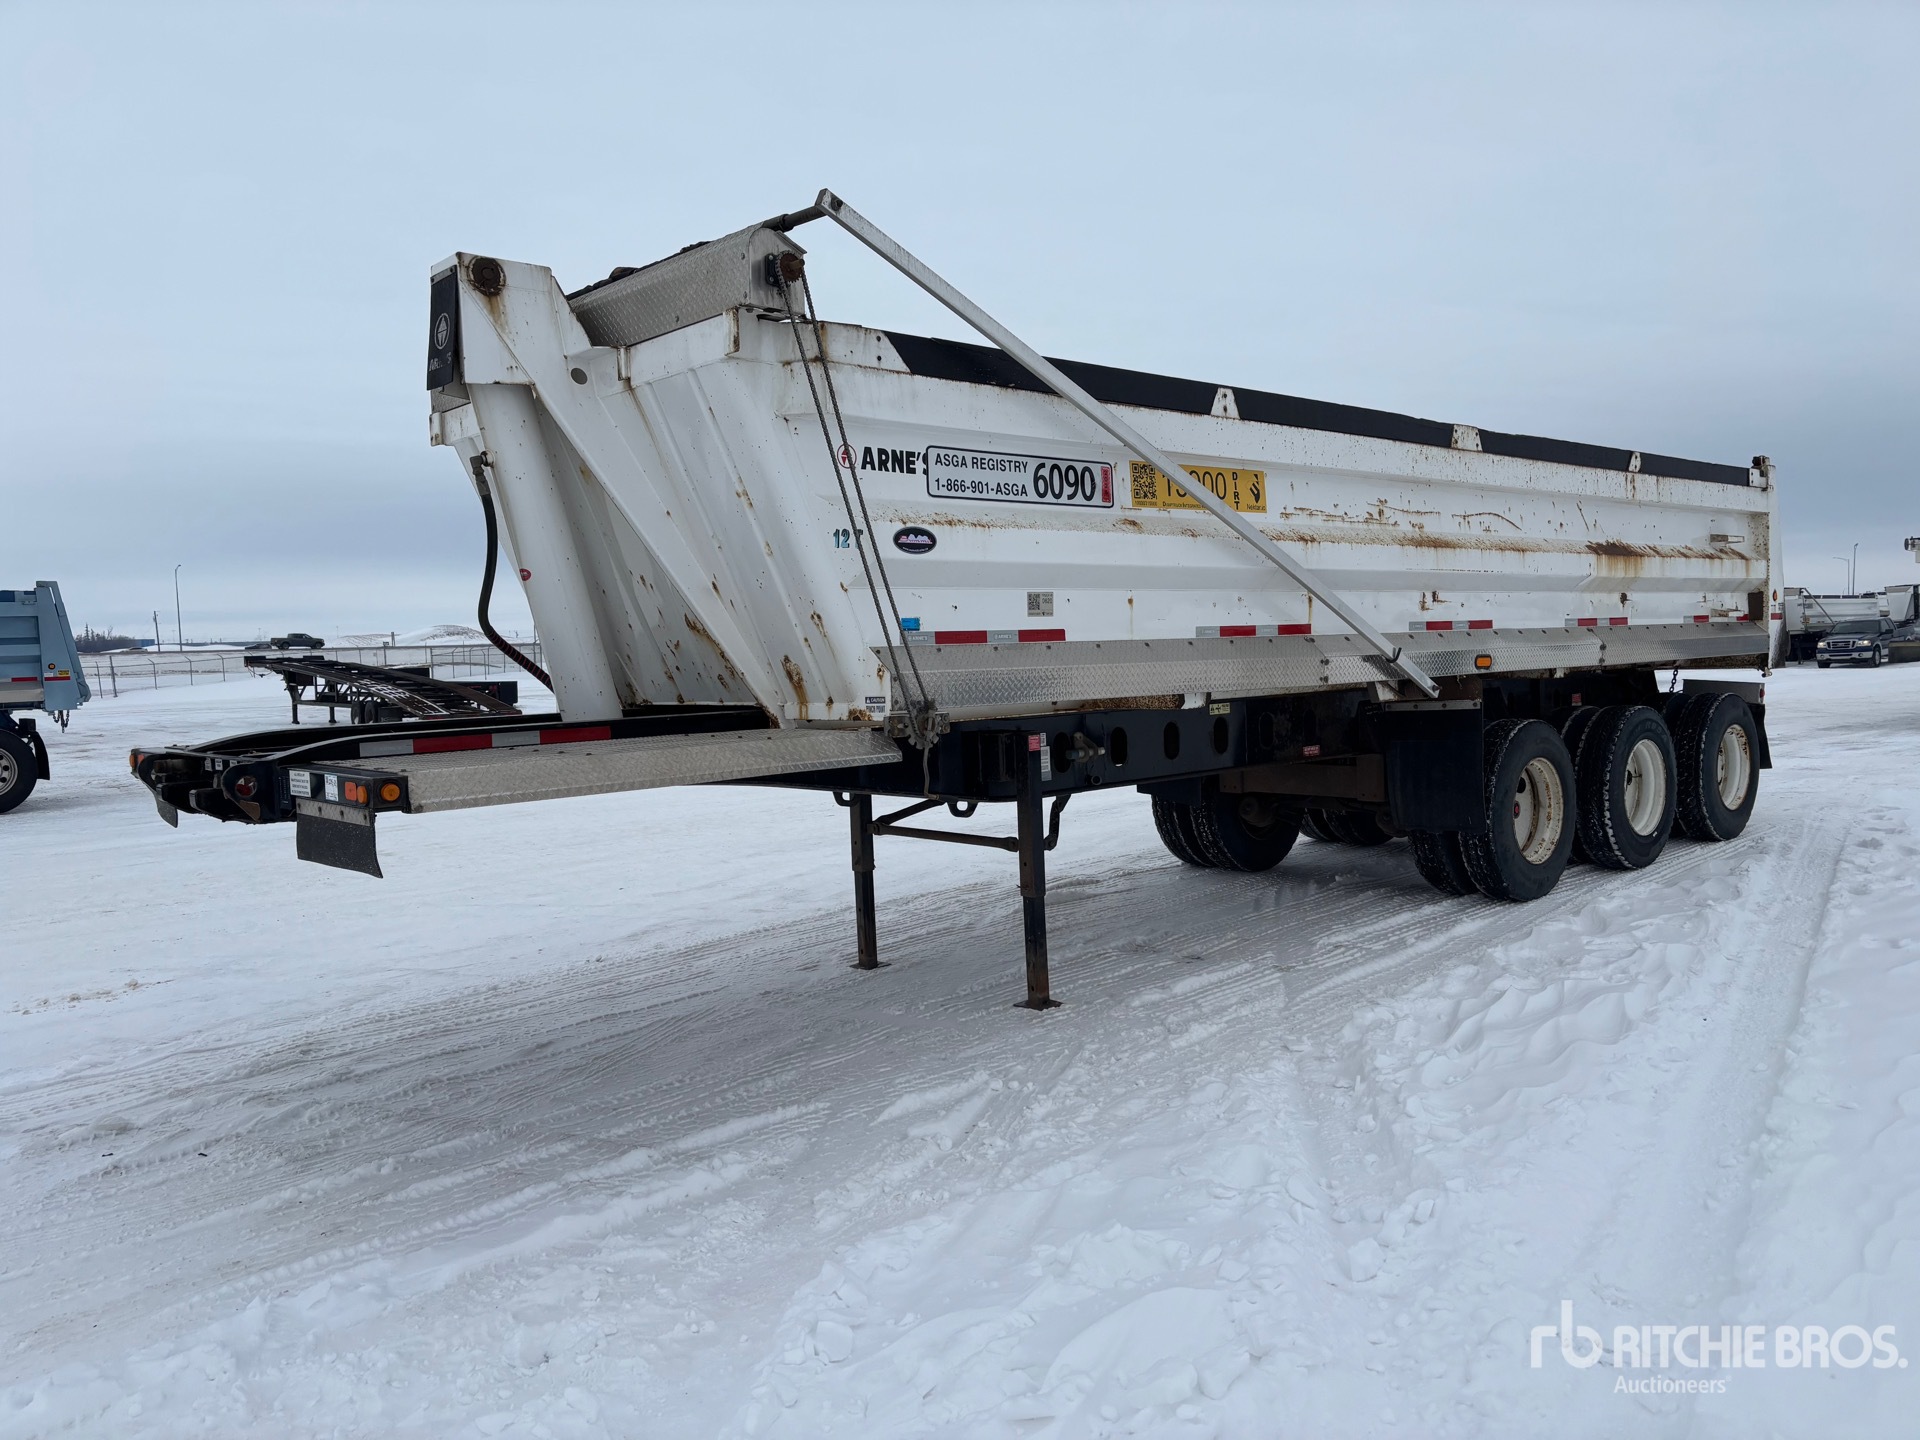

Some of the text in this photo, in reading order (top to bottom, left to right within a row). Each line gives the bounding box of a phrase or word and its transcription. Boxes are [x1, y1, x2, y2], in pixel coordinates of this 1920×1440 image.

[934, 452, 1029, 474] ASGA REGISTRY
[934, 477, 1029, 497] 1-866-901-ASGA
[1033, 462, 1097, 502] 6090
